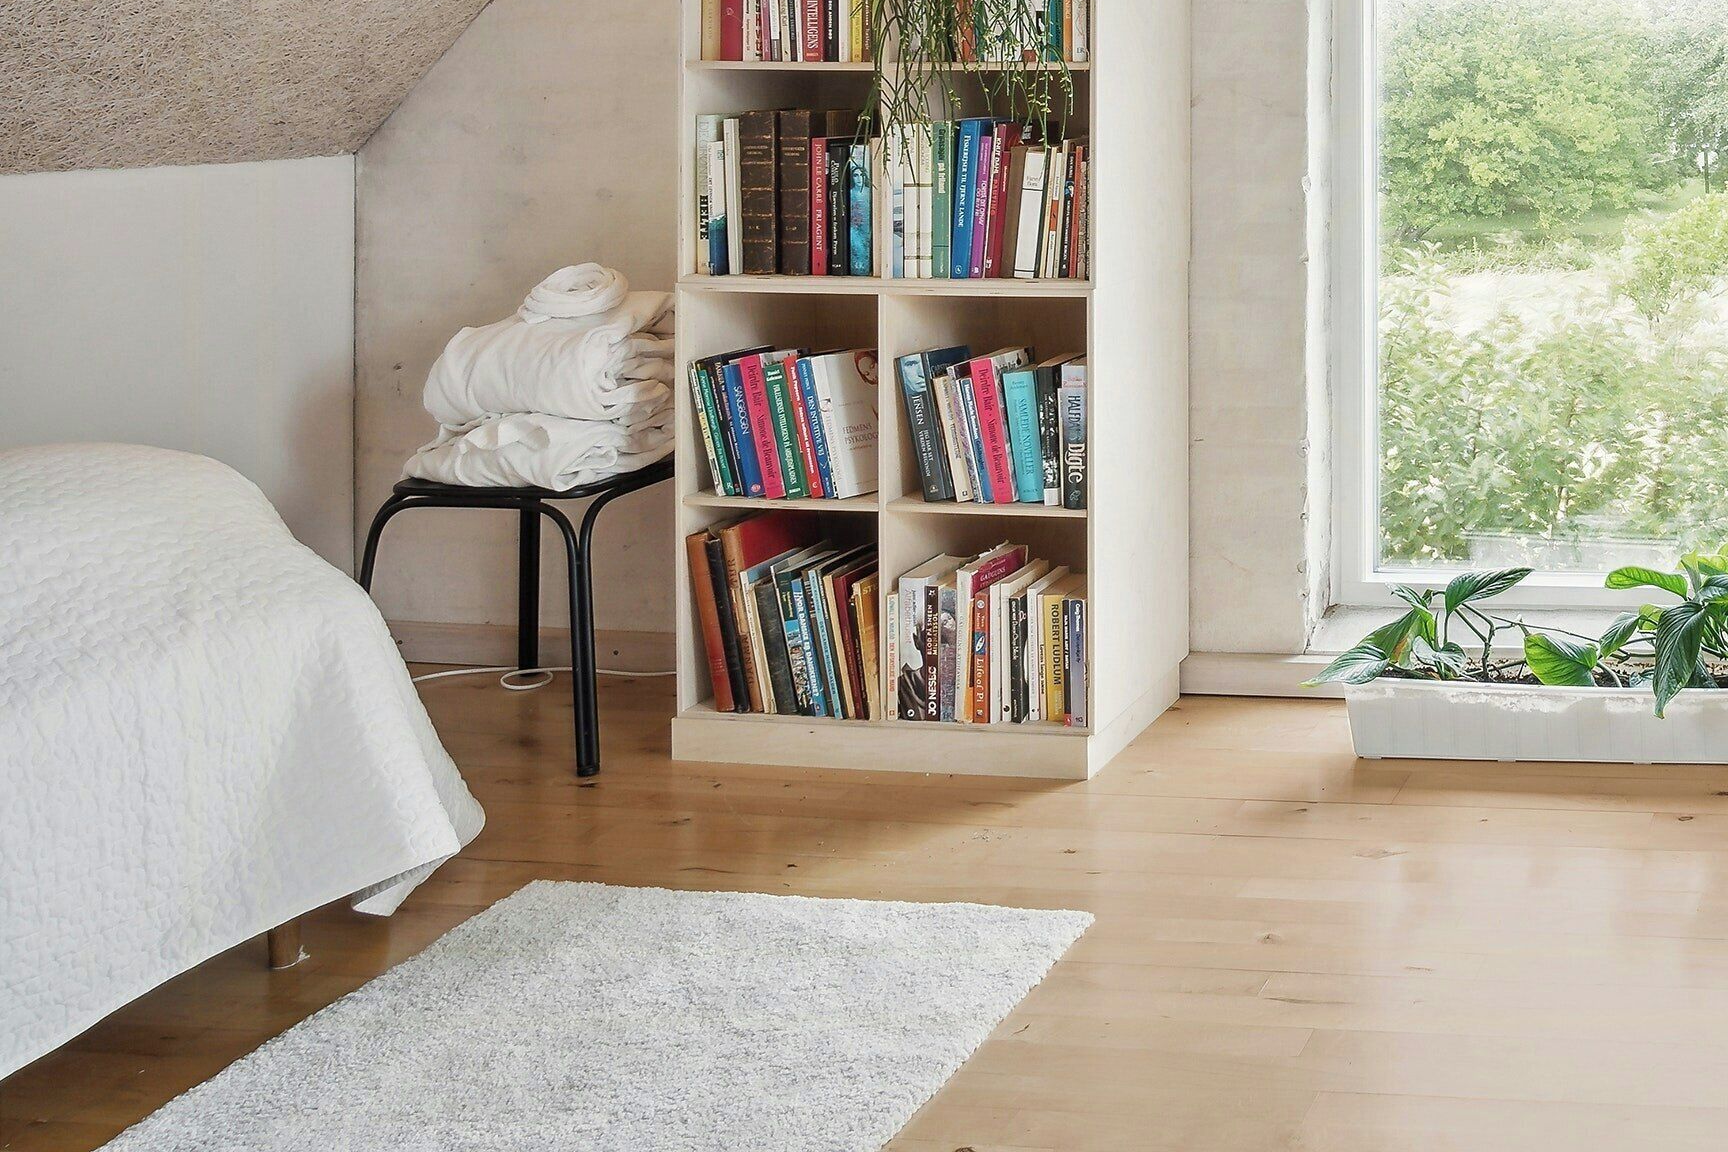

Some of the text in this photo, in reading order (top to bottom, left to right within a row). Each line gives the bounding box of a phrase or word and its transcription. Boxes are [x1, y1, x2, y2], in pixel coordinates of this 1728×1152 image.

[807, 0, 818, 48] INTELLIGENS
[816, 166, 822, 175] LE
[700, 195, 708, 239] HELTE
[734, 386, 749, 435] SANGBOGEN
[912, 395, 924, 425] JENSEN
[1064, 444, 1086, 483] Digte
[976, 658, 984, 678] Life
[1053, 645, 1061, 685] LUDLUM
[928, 702, 937, 716] JO
[977, 693, 984, 702] Pi
